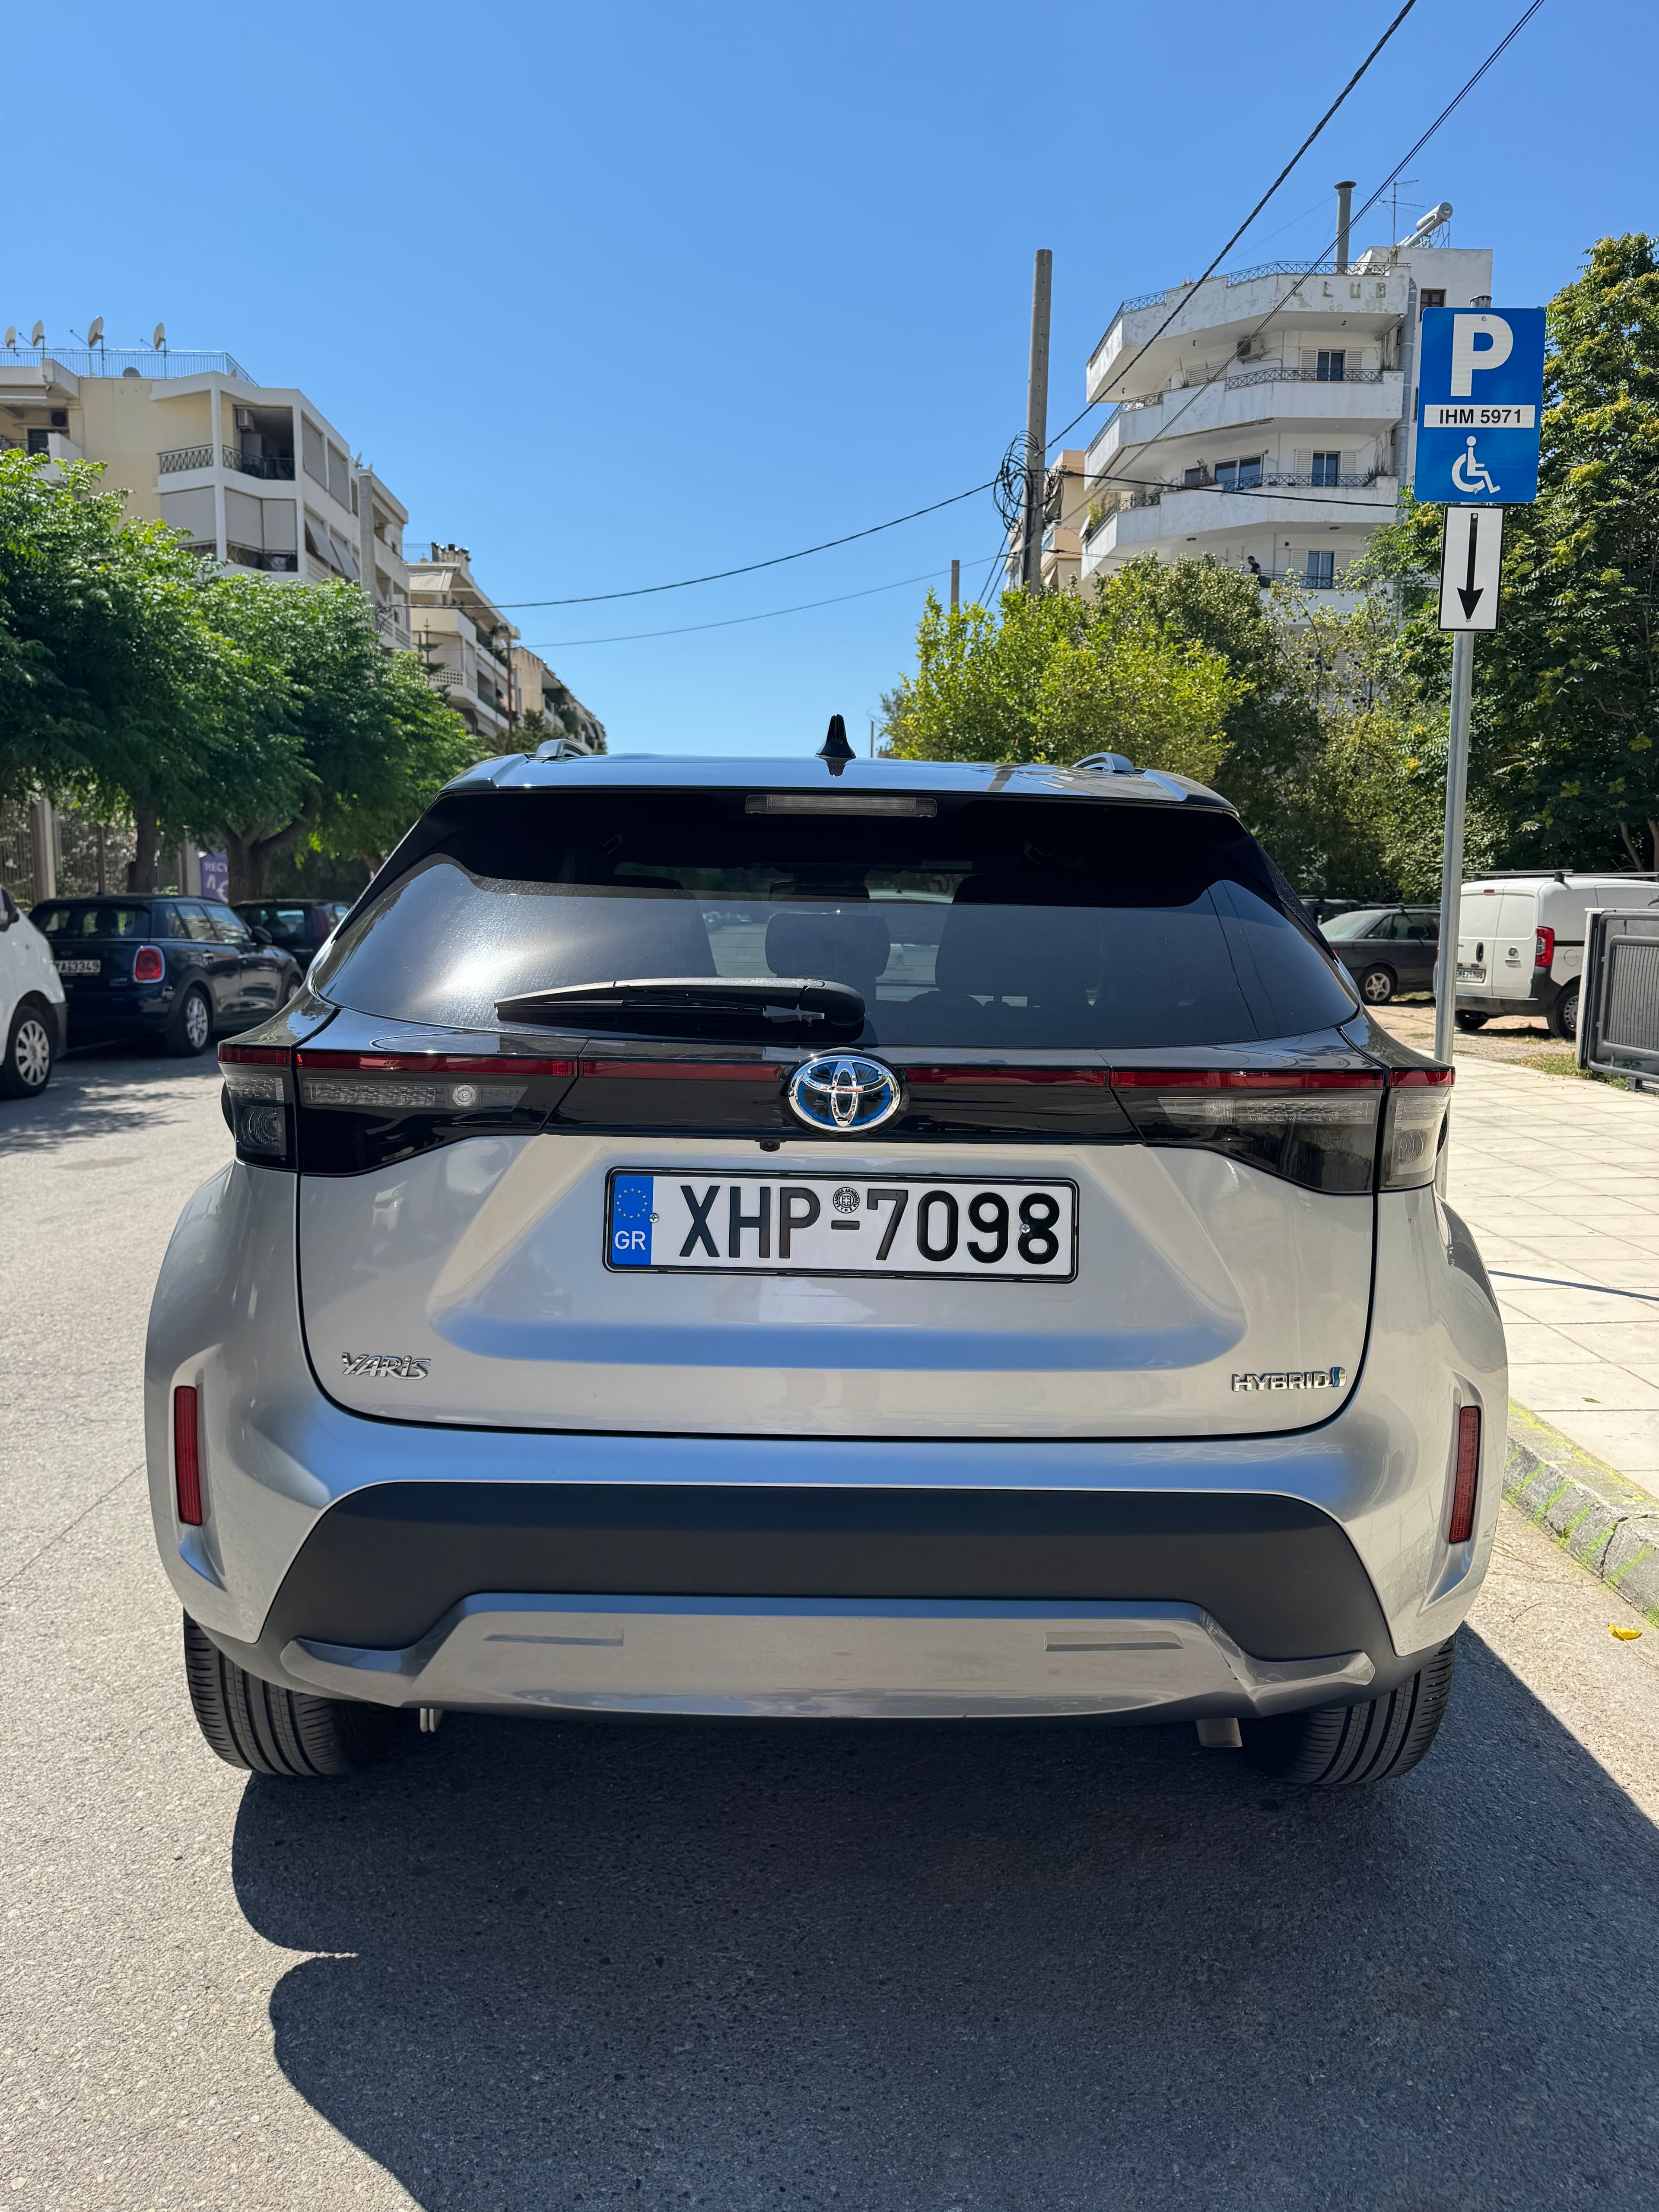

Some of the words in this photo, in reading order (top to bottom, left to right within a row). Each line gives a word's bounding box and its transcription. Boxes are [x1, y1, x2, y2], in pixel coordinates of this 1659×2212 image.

[1450, 314, 1513, 397] P
[1440, 409, 1474, 424] IHM
[1480, 409, 1521, 424] 5971
[679, 1185, 1060, 1264] XHP-7098
[615, 1230, 646, 1250] GR
[1232, 1371, 1330, 1392] HYBRID
